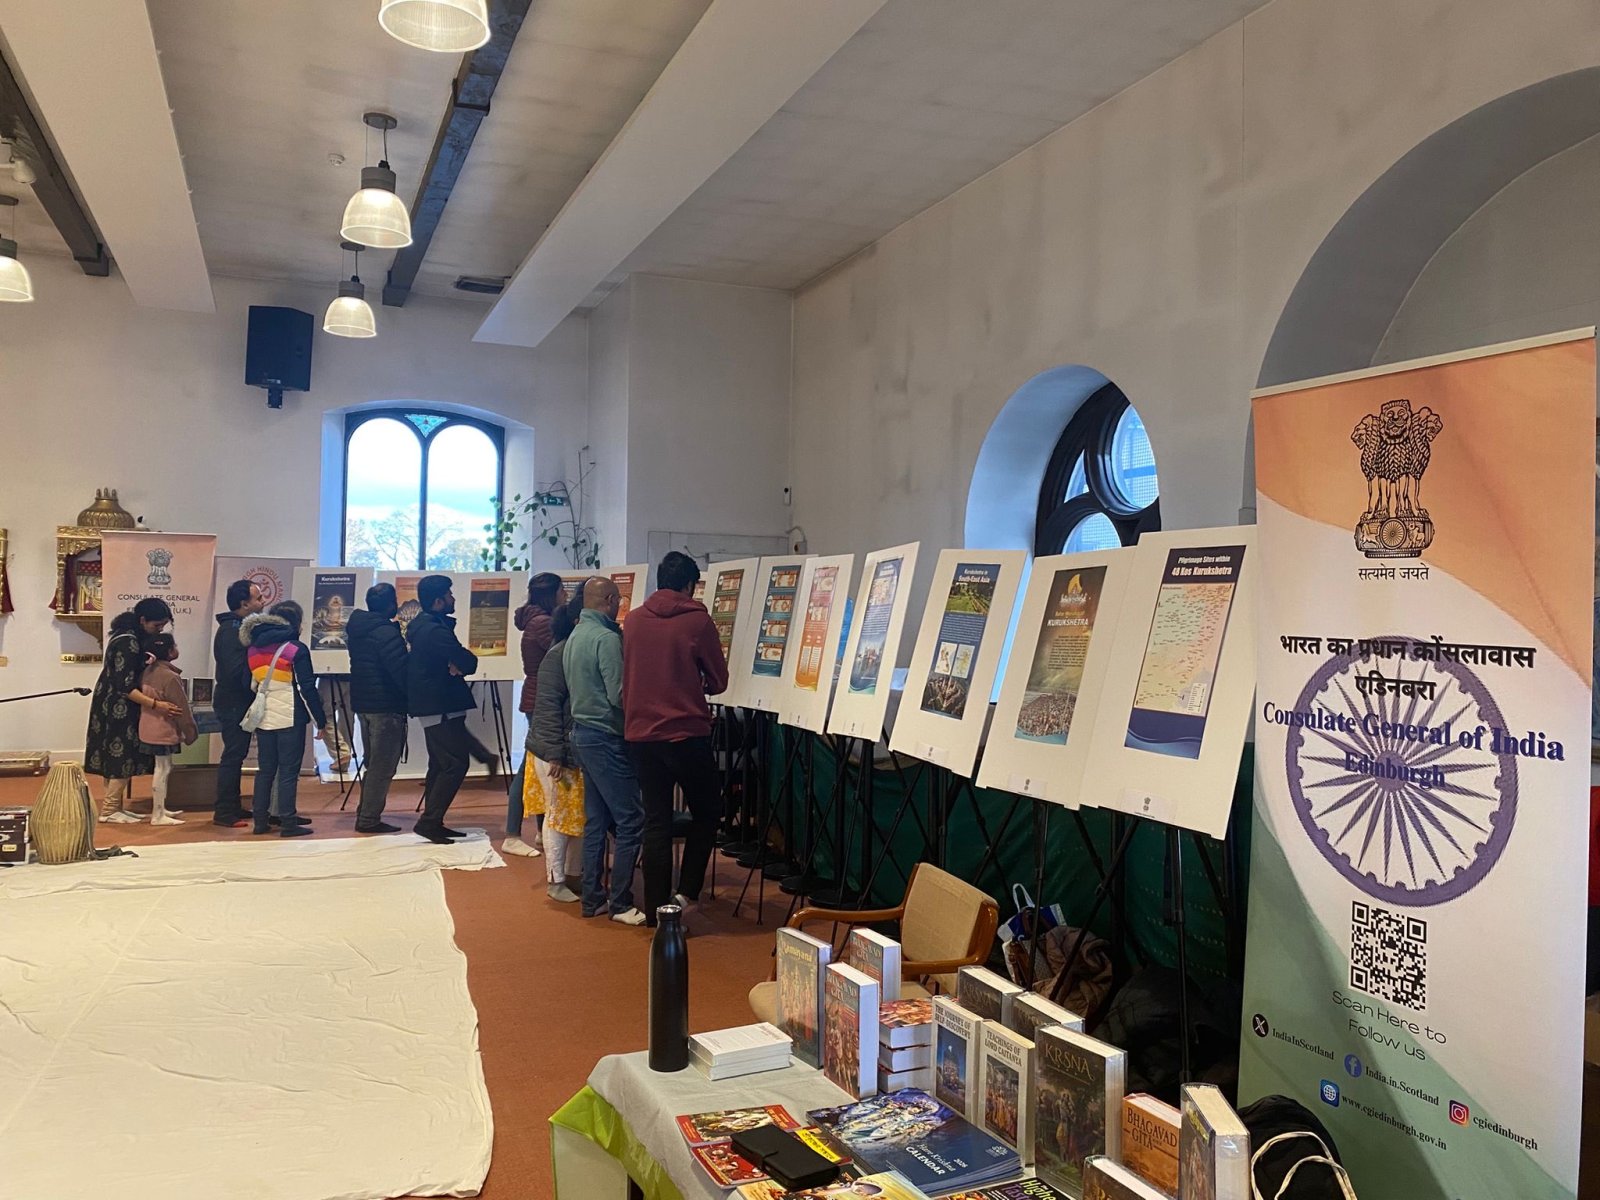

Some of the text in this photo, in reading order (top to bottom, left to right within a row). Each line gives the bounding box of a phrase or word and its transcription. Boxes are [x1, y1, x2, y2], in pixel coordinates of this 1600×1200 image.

[1171, 566, 1232, 576] 48 Kos Kurukshetra
[1358, 562, 1430, 581] सत्यमेव जयते
[1047, 617, 1089, 627] KURUKSHETRA
[1280, 635, 1536, 668] भारत का प्रधान कोंसलावास
[1355, 671, 1436, 701] एडिनबरा
[1263, 702, 1565, 762] Consulate General of India
[1345, 751, 1446, 791] Edinburgh
[935, 1004, 944, 1015] THE
[945, 1010, 964, 1027] JOURNEY
[1332, 990, 1447, 1044] Scan Here to
[985, 1038, 998, 1052] LORD
[987, 1030, 1021, 1056] TEACHINGS OF
[1272, 1028, 1335, 1060] IndiaInScotland
[1349, 1019, 1427, 1061] Follow us
[1365, 1066, 1440, 1106] India.in.Scotland
[1127, 1107, 1178, 1147] BHAGAVAD
[1342, 1095, 1447, 1151] www.cgiedinburgh.gov.in
[1473, 1115, 1539, 1151] cgiedinburgh
[906, 1146, 945, 1175] CALENDAR
